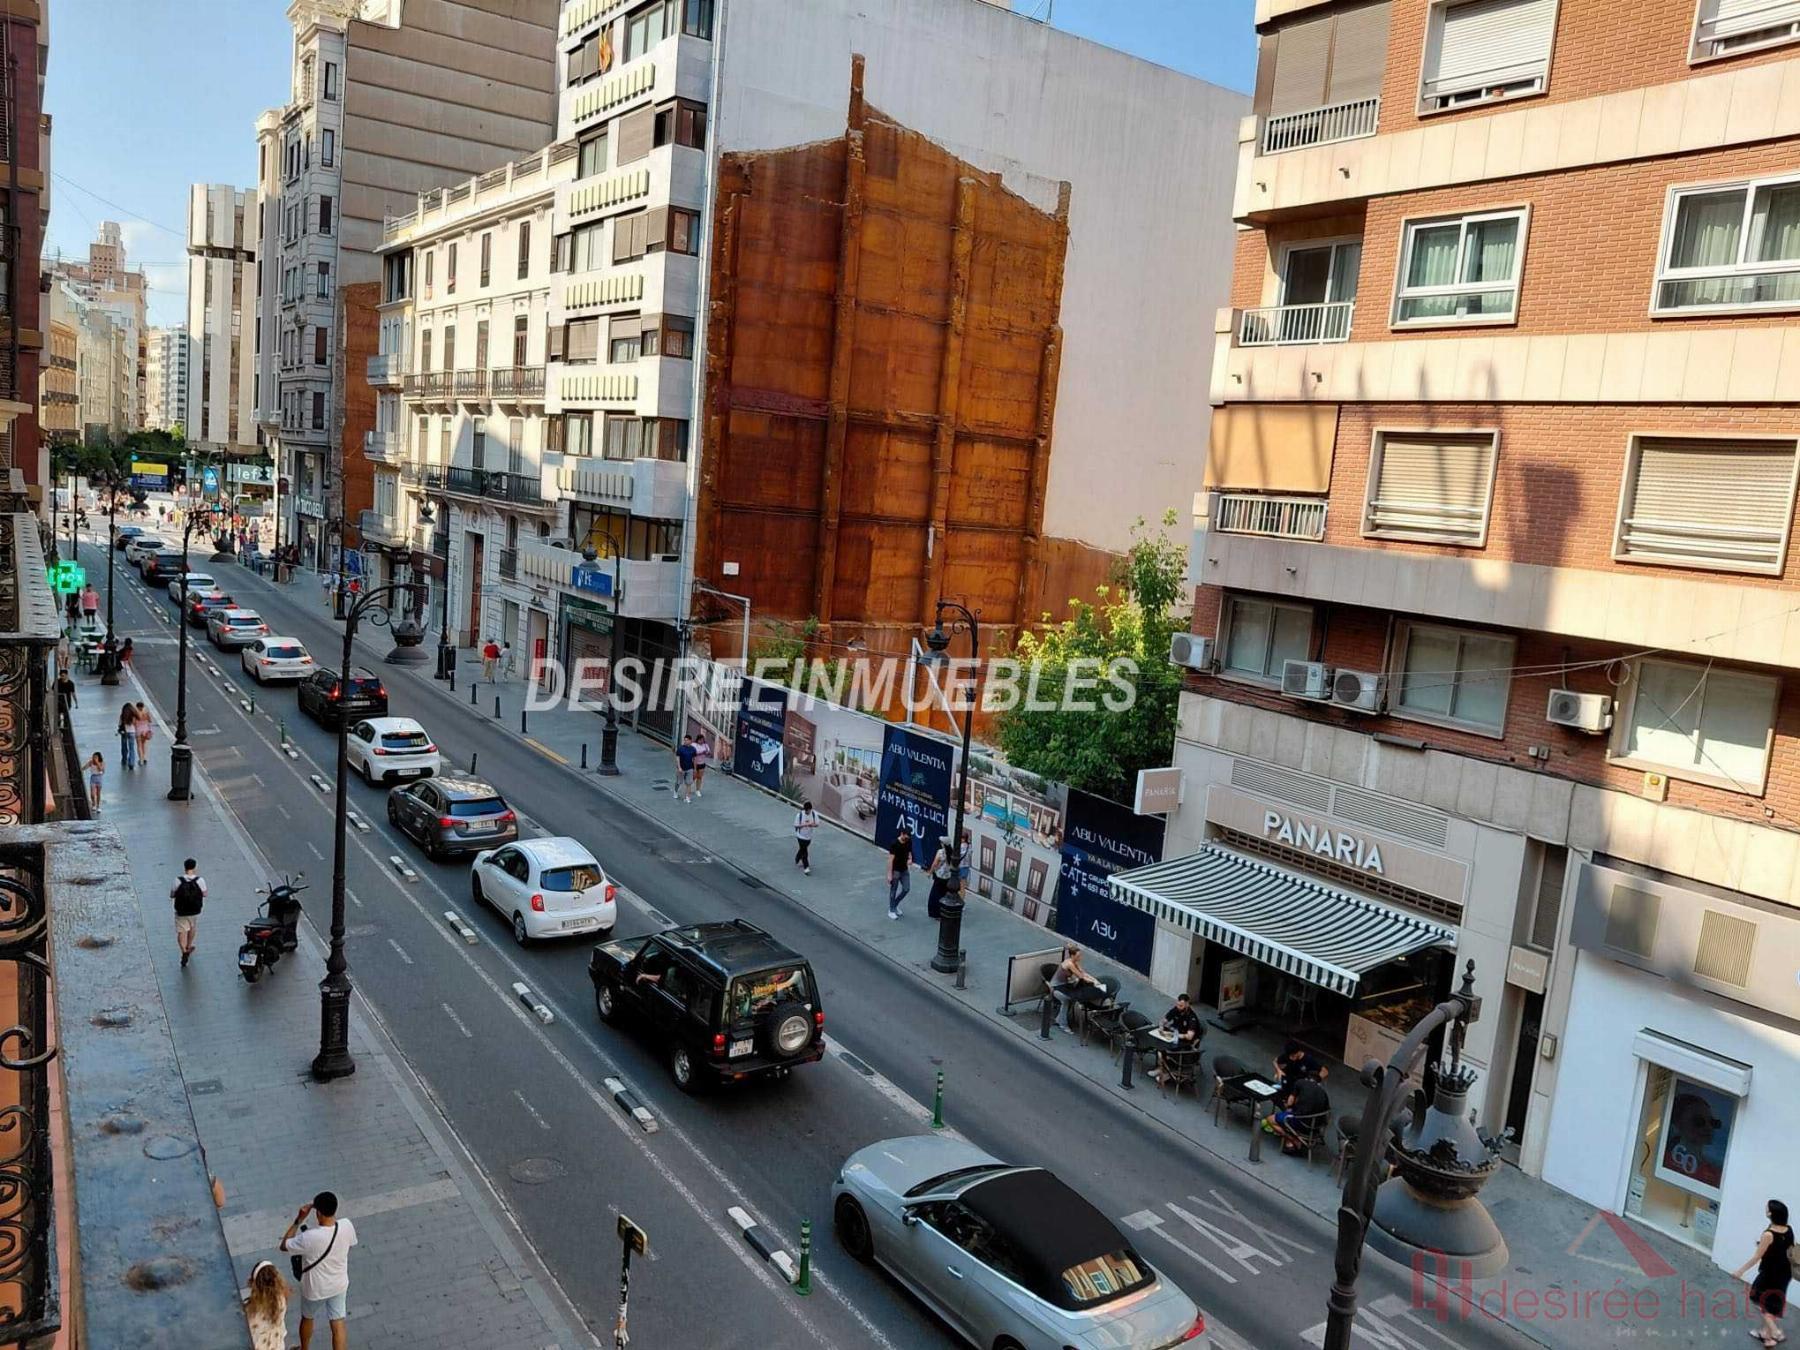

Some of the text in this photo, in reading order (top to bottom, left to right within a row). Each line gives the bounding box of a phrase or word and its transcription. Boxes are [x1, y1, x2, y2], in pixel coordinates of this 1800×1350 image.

[888, 743, 946, 771] ABU VALENTIA
[896, 813, 925, 839] ABU
[1072, 826, 1155, 864] ABU VALENTIA
[1263, 809, 1385, 874] PANARIA
[1091, 919, 1117, 941] ABU
